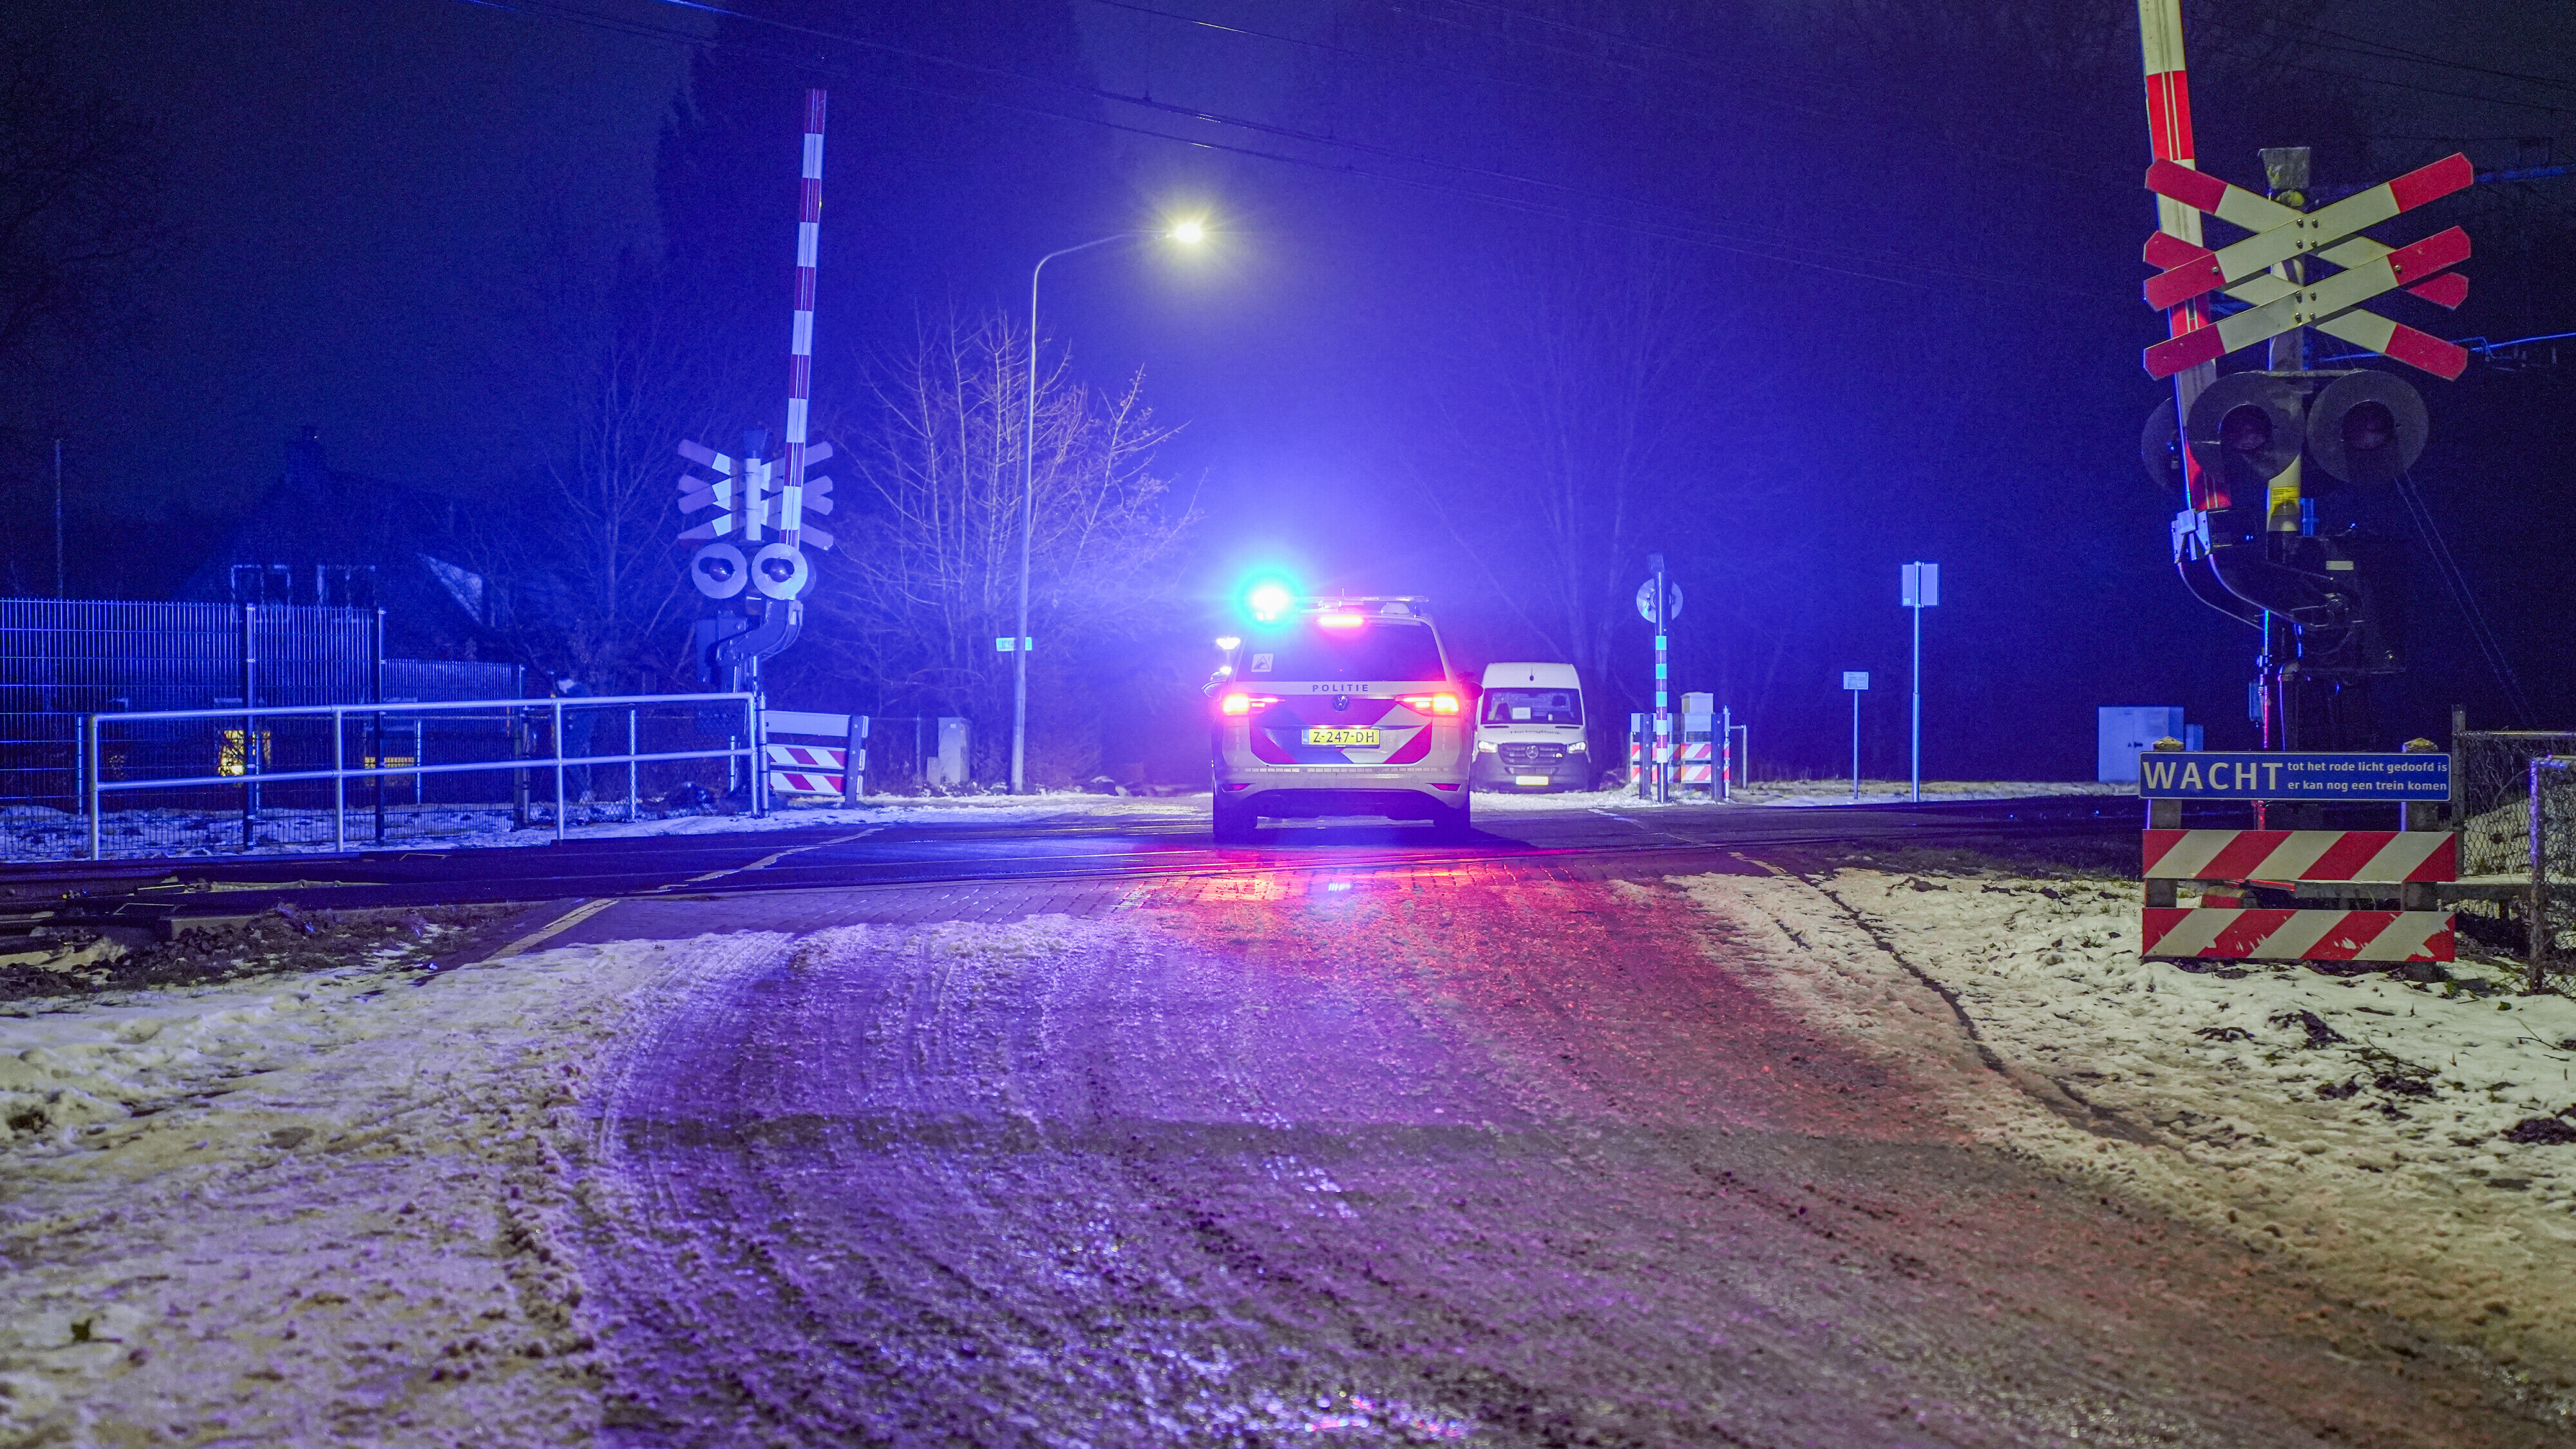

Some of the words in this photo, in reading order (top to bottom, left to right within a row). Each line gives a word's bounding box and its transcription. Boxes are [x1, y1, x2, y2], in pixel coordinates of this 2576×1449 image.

[1313, 732, 1374, 743] Z-247-DH
[2287, 762, 2304, 771] tot
[2307, 762, 2326, 771] het
[2329, 762, 2355, 772] rode
[2358, 762, 2384, 772] licht
[2387, 762, 2434, 774] gedoofd
[2438, 762, 2448, 772] is
[2143, 762, 2283, 790] WACHT
[2303, 781, 2323, 790] kan
[2327, 782, 2348, 792] nog
[2376, 781, 2404, 790] trein
[2407, 781, 2447, 790] komen
